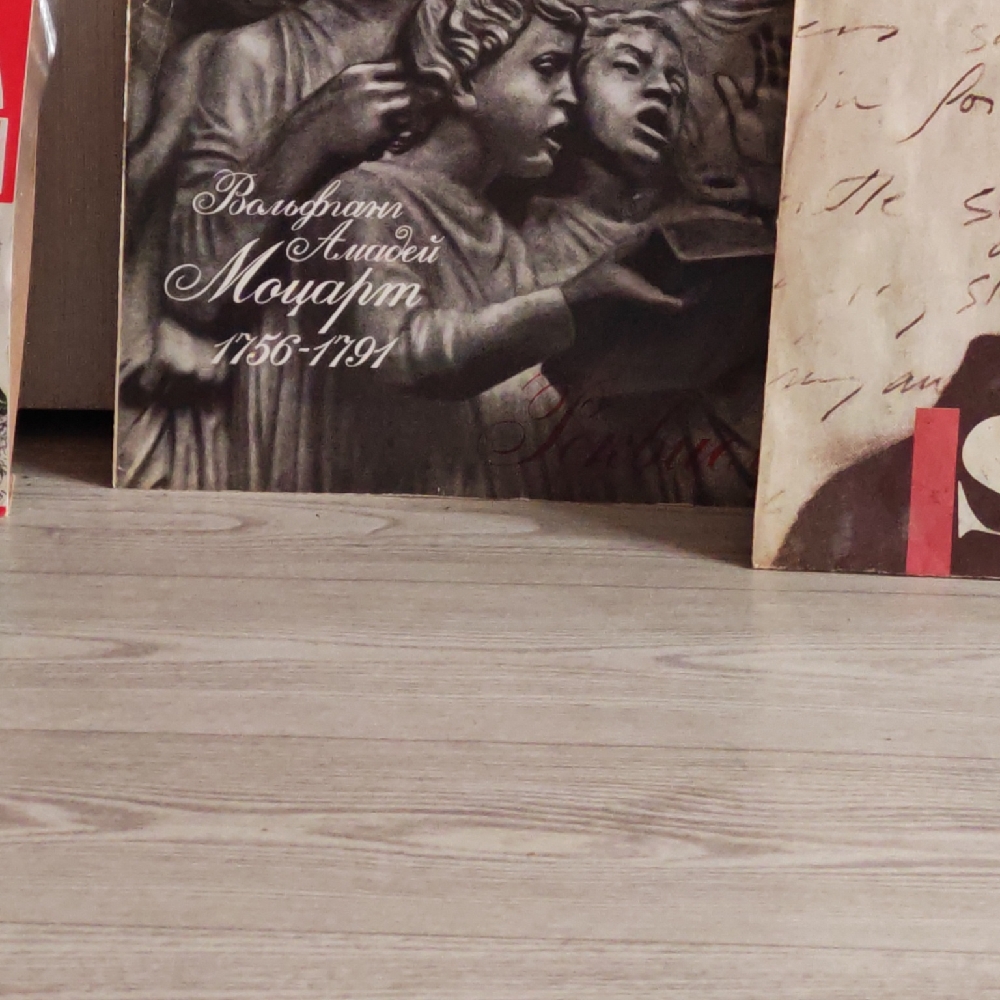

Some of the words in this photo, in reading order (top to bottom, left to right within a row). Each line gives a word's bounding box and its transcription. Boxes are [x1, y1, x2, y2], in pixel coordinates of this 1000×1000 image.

[192, 168, 404, 231] Вольфганг
[285, 218, 446, 263] Амадей
[163, 237, 424, 335] Моцарт
[211, 332, 400, 369] 1756-1791
